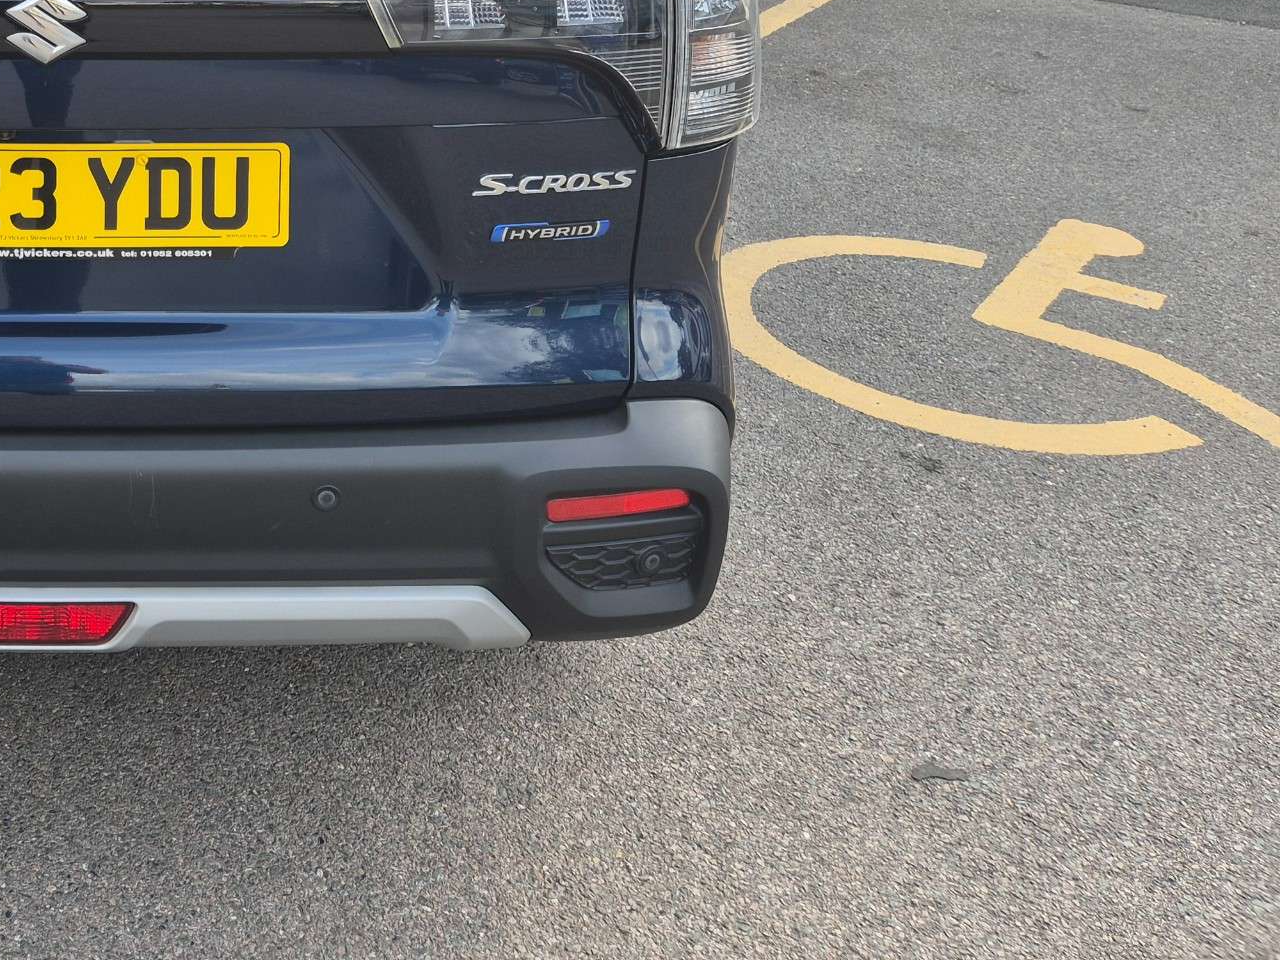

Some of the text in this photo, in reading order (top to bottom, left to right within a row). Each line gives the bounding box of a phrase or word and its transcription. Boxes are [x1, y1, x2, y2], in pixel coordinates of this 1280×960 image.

[87, 157, 250, 231] YDU
[509, 225, 593, 241] HYBRID
[121, 249, 138, 257] tel:
